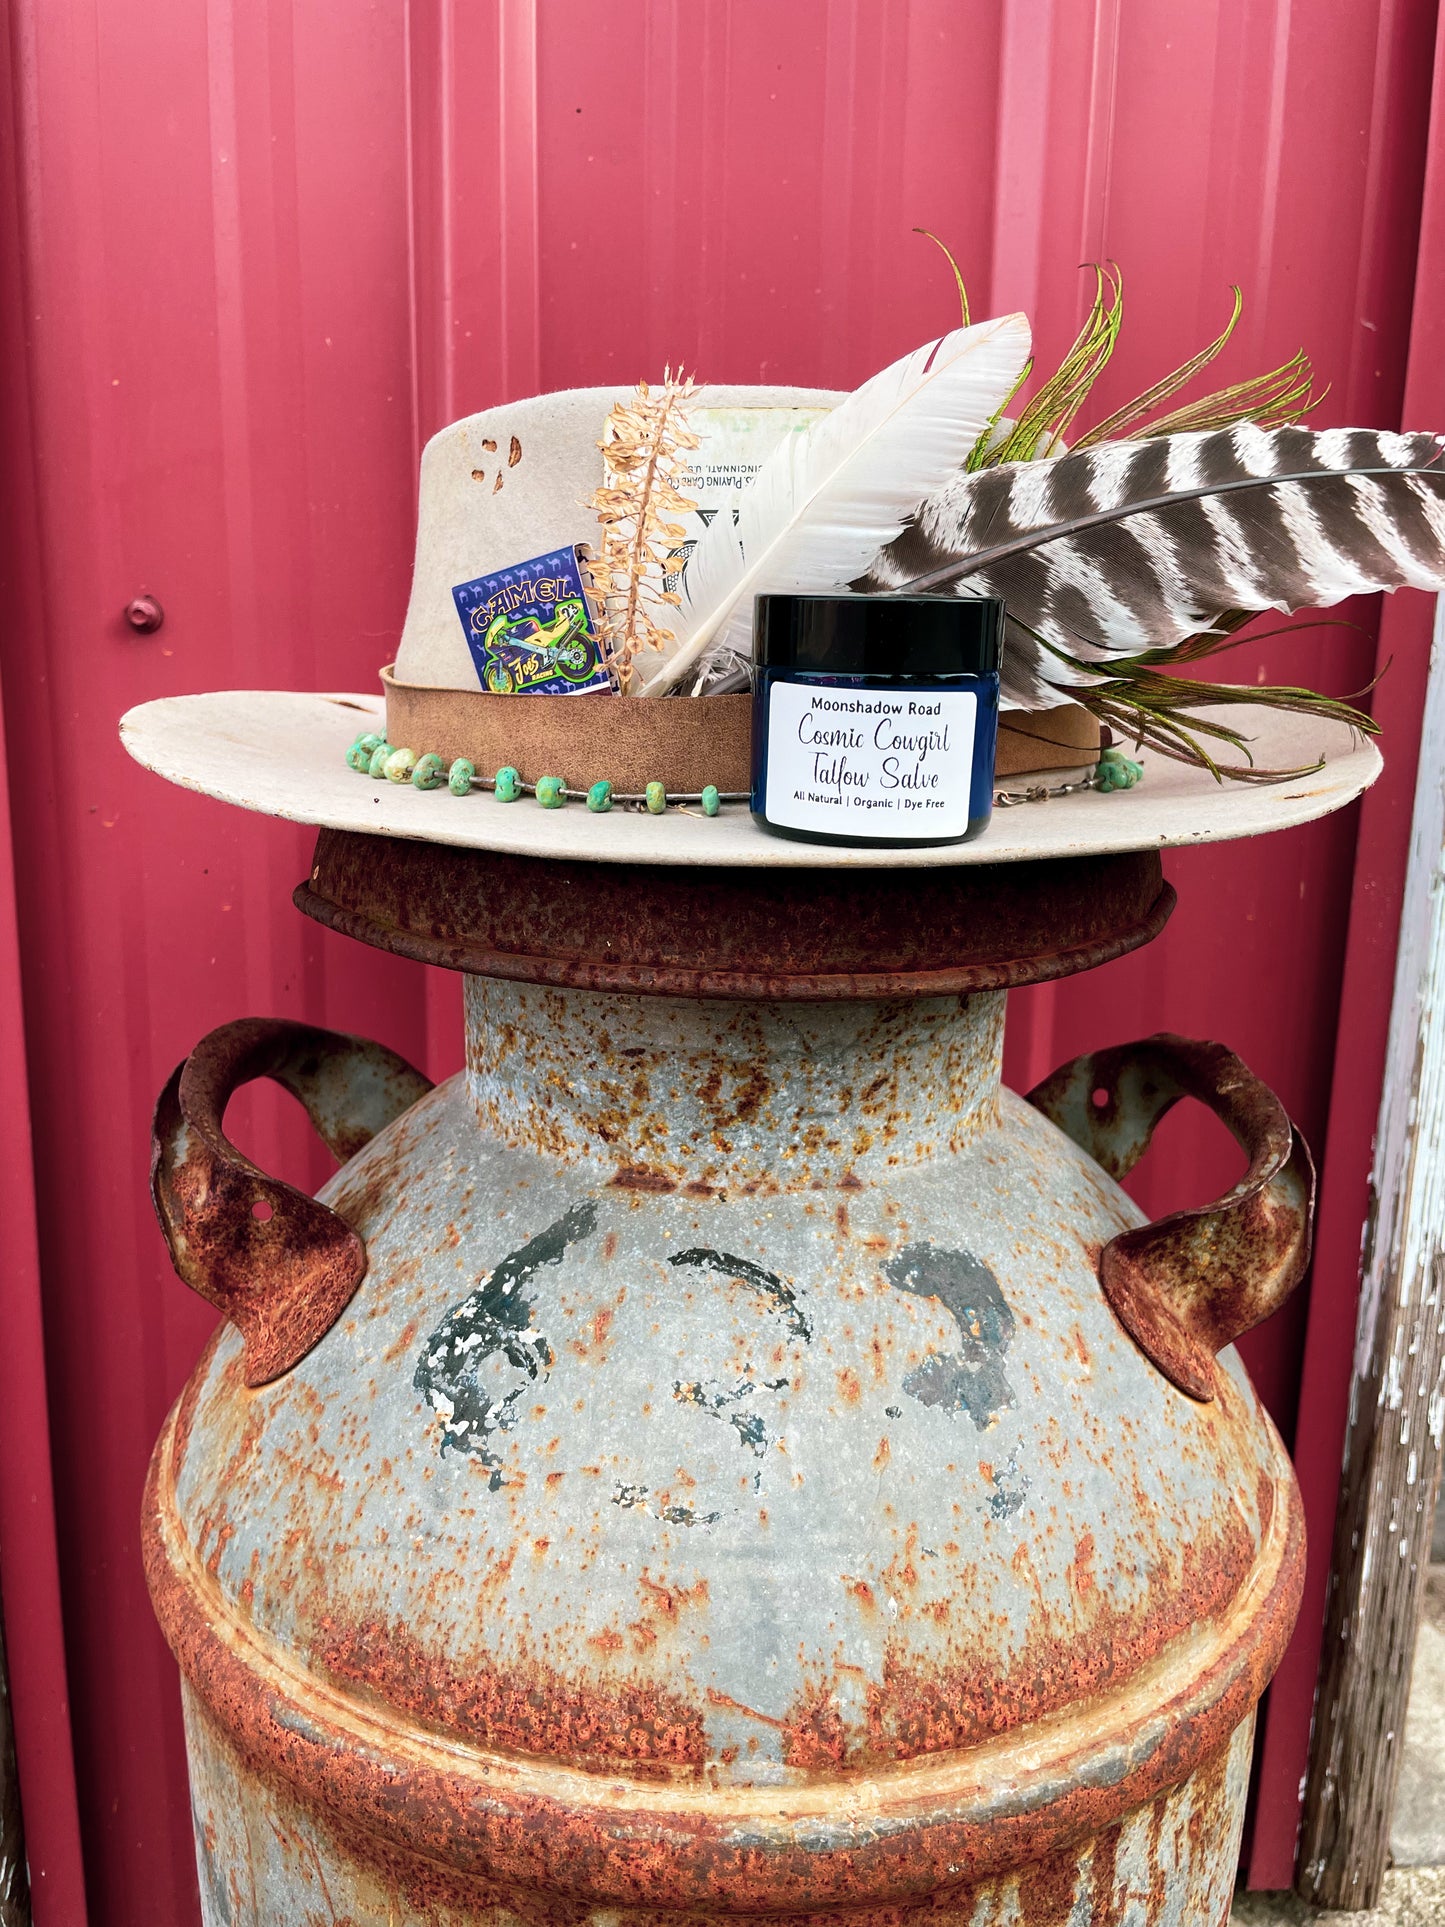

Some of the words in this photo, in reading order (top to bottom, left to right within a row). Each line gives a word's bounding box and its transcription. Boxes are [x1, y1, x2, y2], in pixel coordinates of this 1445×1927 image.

[470, 577, 578, 634] CAMEL
[811, 696, 903, 715] Moonshadow
[908, 701, 941, 716] Road
[798, 712, 865, 749] Cosmic
[873, 717, 951, 762] Cowgirl
[808, 751, 871, 795] Tallow
[879, 756, 940, 790] Salve
[793, 790, 805, 801] All
[808, 792, 843, 805] Natural
[853, 796, 893, 809] Organic
[904, 798, 923, 811] Dye
[925, 798, 945, 809] Free
